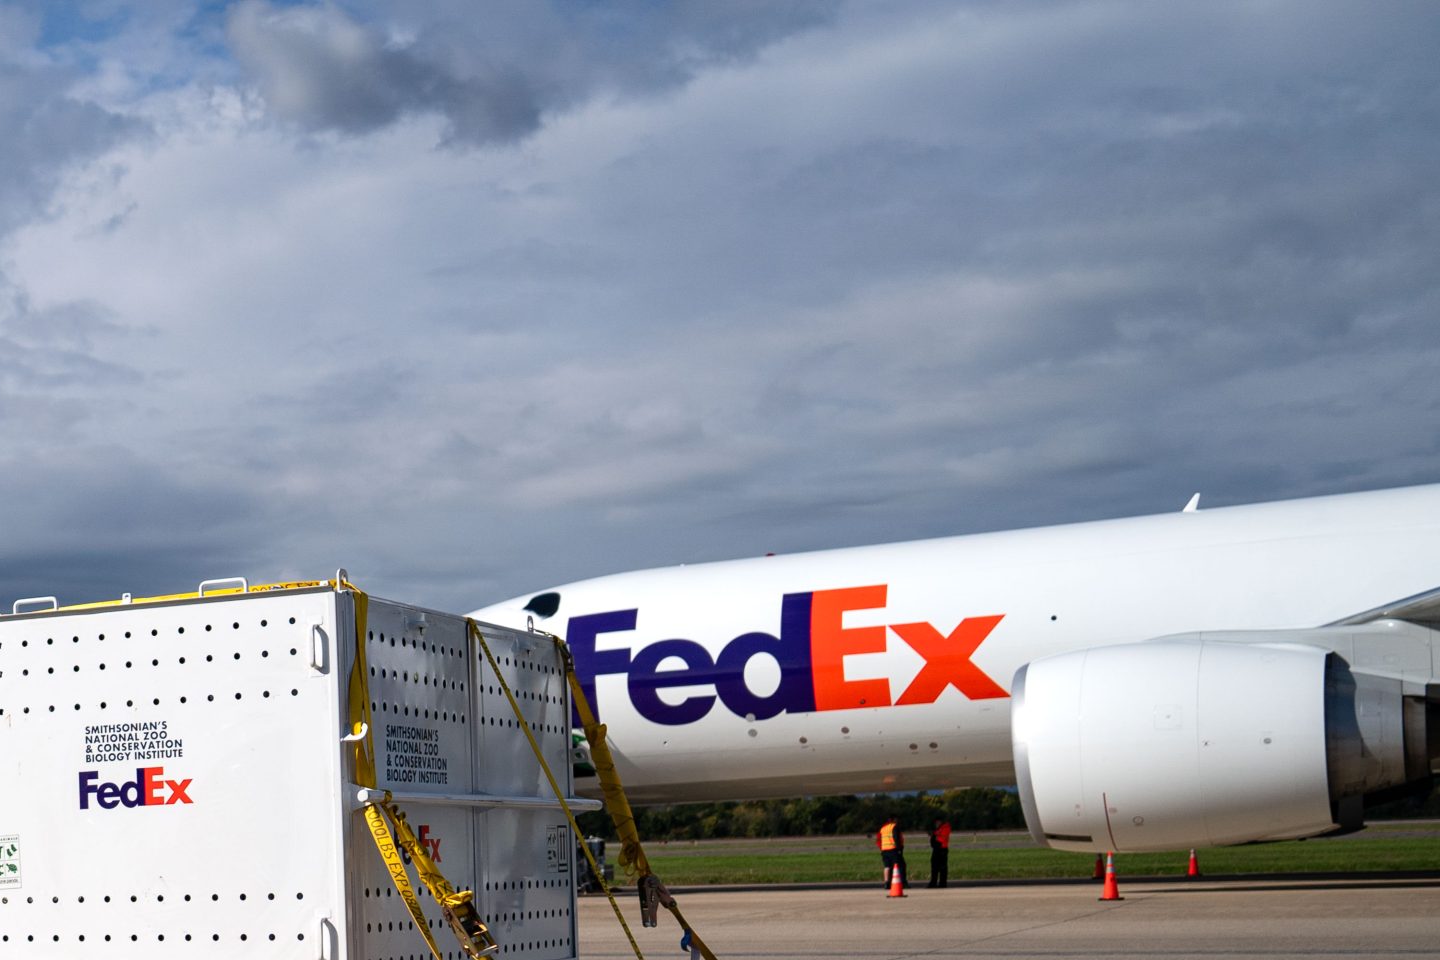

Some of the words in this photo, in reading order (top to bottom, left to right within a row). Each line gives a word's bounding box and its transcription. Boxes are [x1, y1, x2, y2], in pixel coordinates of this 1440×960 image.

[565, 584, 1012, 726] FedEx
[85, 721, 168, 735] SMITHSONIAN'S
[386, 724, 439, 742] SMITHSONIAN'S
[85, 733, 140, 744] NATIONAL
[143, 730, 168, 740] ZOO
[86, 744, 93, 754] &
[97, 739, 183, 753] CONSERVATION
[386, 739, 422, 755] NATIONAL
[424, 742, 439, 756] ZOO
[85, 752, 131, 763] BIOLOGY
[134, 749, 183, 760] INSTITUTE
[386, 753, 392, 767] &
[394, 754, 448, 770] CONSERVATION
[386, 768, 417, 783] BIOLOGY
[418, 770, 448, 785] INSTITUTE
[79, 766, 194, 810] FedEx
[389, 862, 409, 887] EXP
